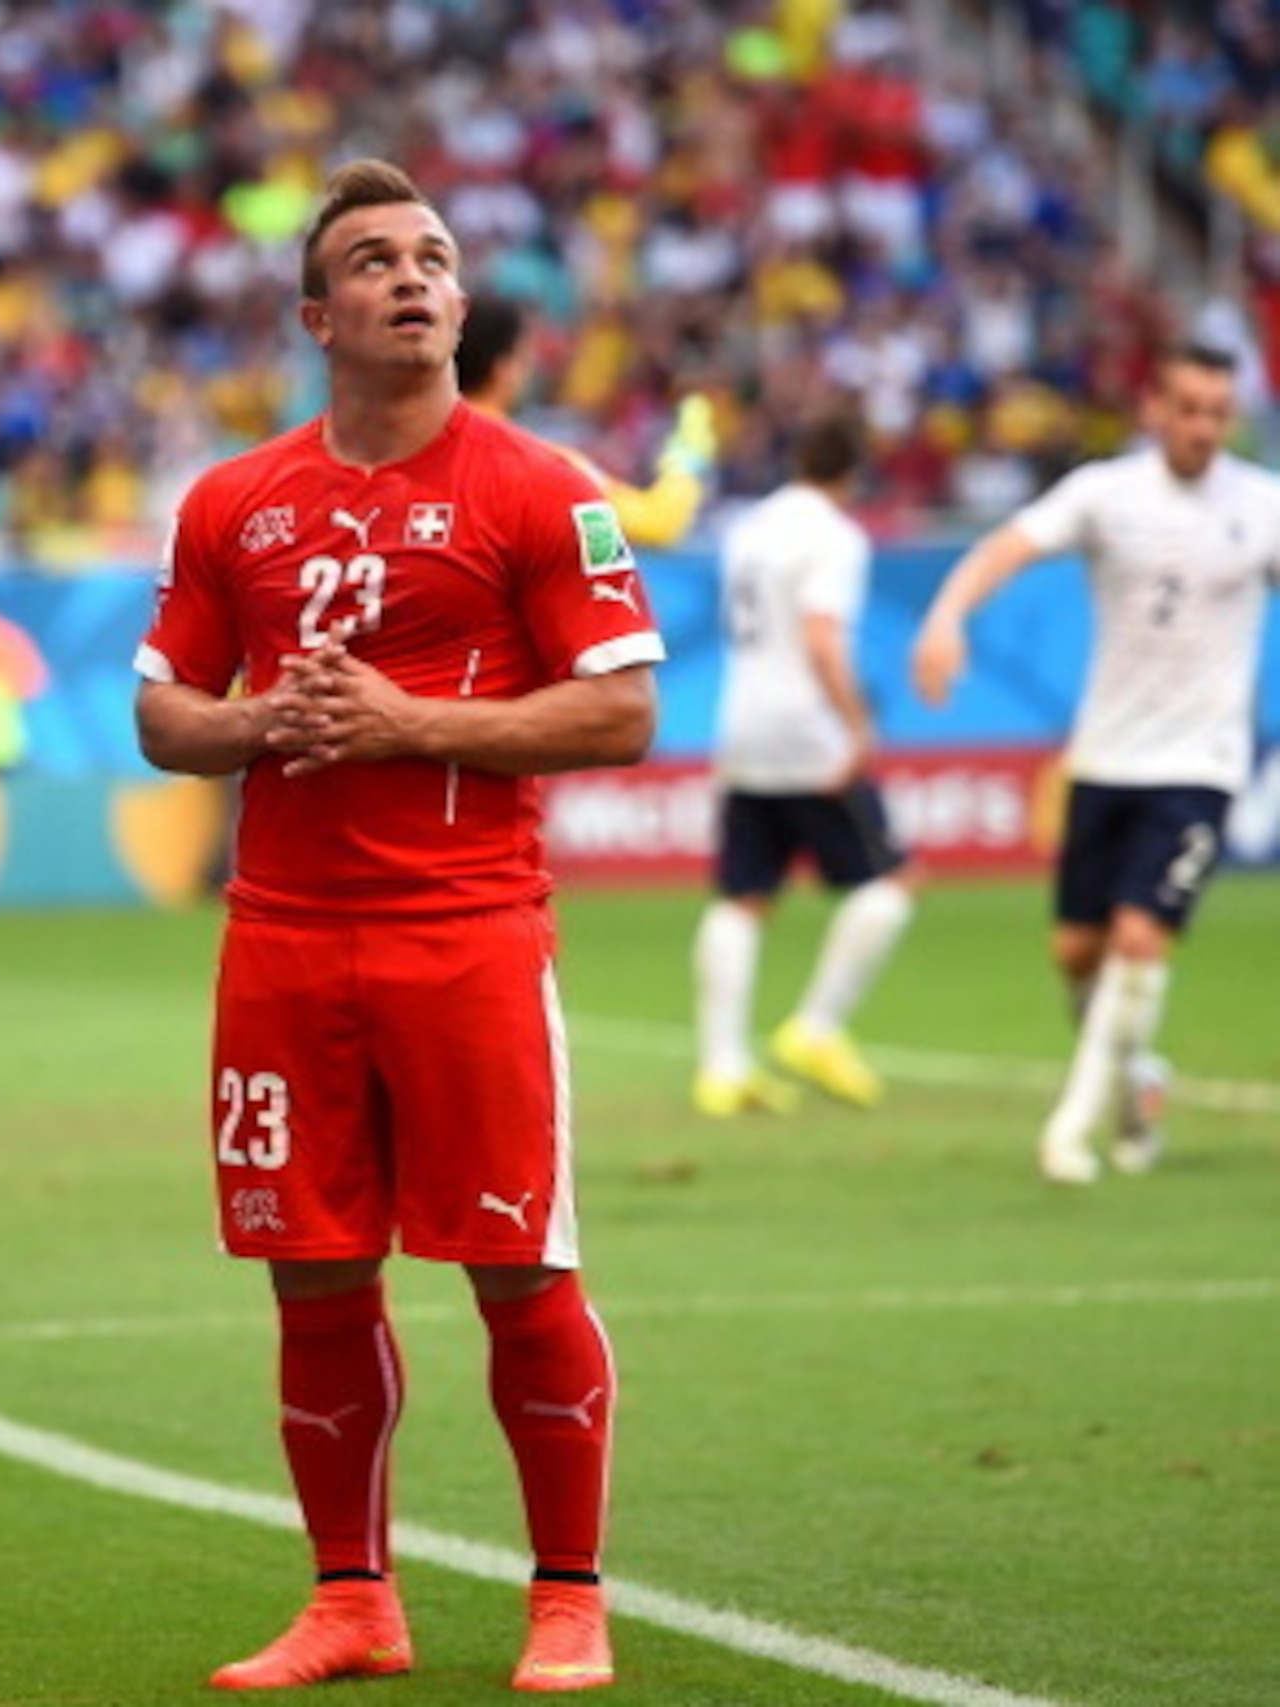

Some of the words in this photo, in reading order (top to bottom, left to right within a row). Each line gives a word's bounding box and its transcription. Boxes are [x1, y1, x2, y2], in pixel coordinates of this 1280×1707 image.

[298, 553, 387, 650] 23
[1166, 822, 1217, 894] 2
[218, 1066, 291, 1170] 23
